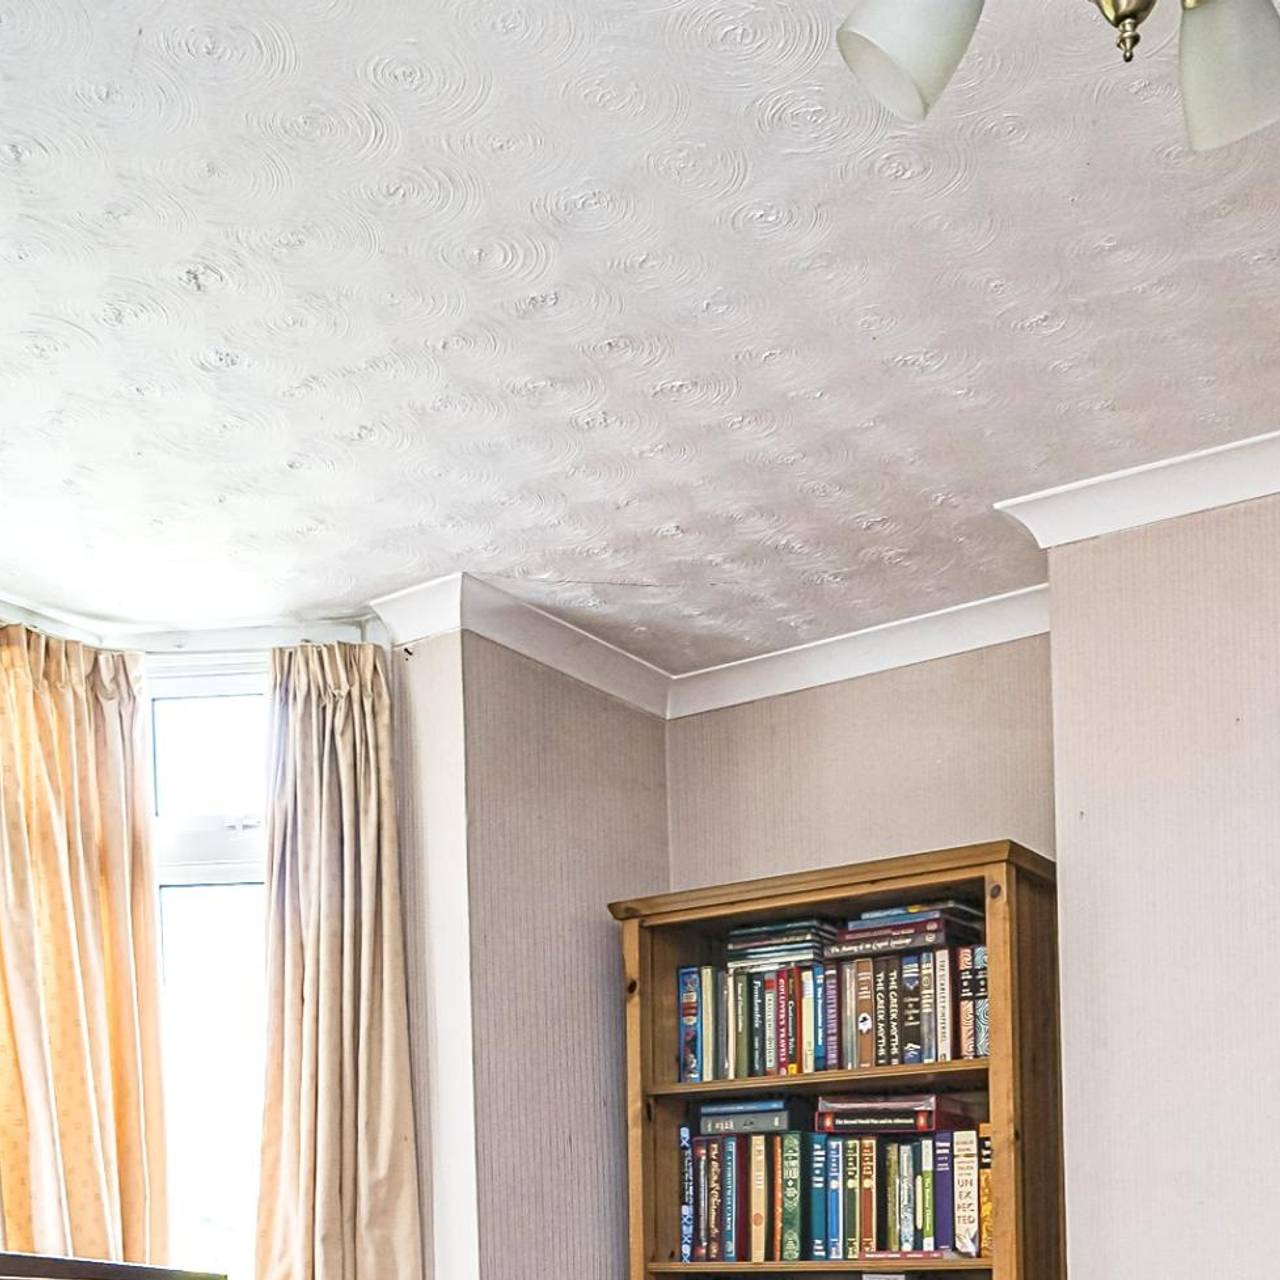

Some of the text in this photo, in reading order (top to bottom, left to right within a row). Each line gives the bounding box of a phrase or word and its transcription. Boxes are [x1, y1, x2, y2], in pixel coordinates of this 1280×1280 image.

[779, 1028, 787, 1063] TRAVELS
[875, 971, 885, 1056] THE GREEK MYTHS
[888, 970, 899, 1055] THE GREEK MYTHS
[938, 974, 948, 1044] SCARLET PIMPERNEL
